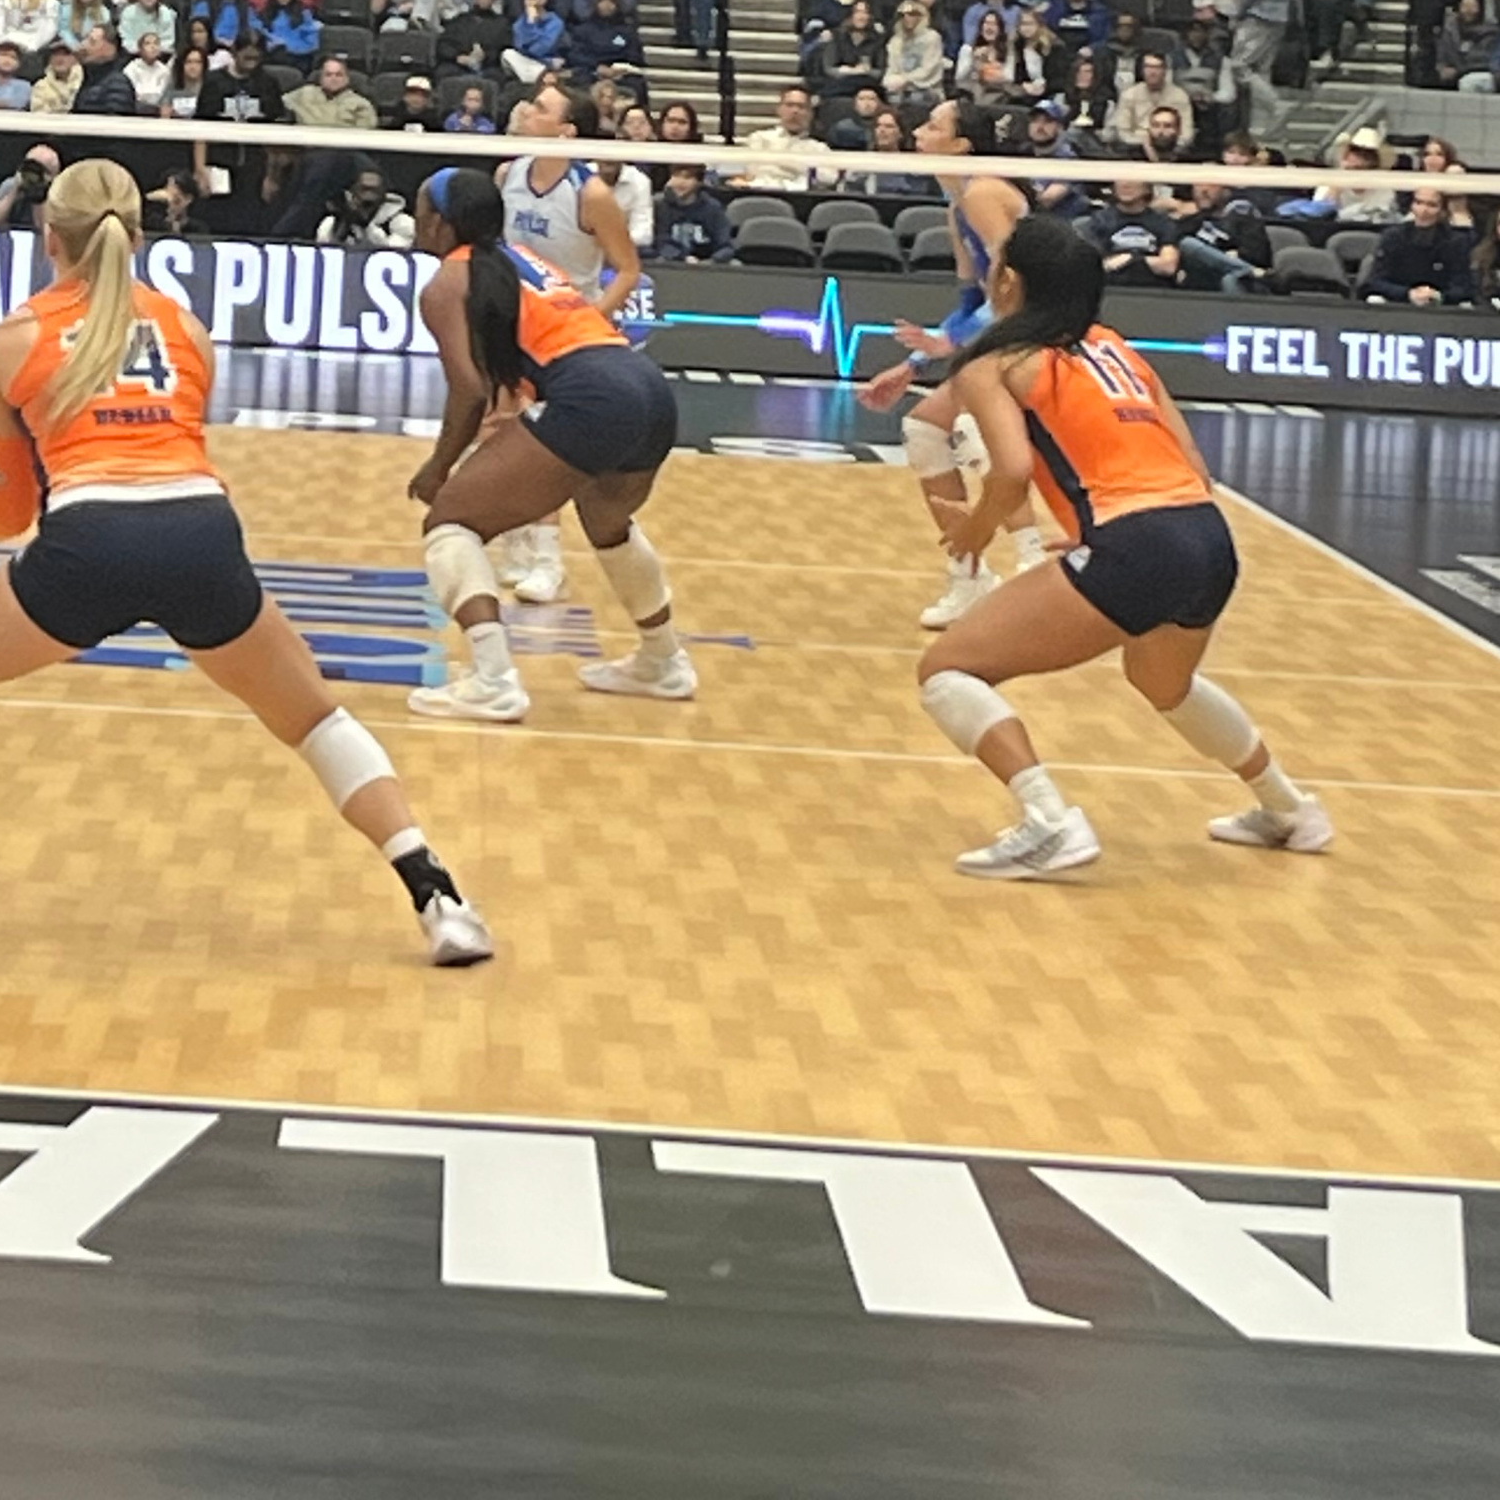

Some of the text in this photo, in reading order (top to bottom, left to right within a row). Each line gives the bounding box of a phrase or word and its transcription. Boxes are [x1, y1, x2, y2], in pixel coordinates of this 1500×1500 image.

[59, 317, 178, 397] 4
[1077, 338, 1156, 405] 11
[1226, 325, 1330, 378] FEEL
[1339, 331, 1423, 384] THE
